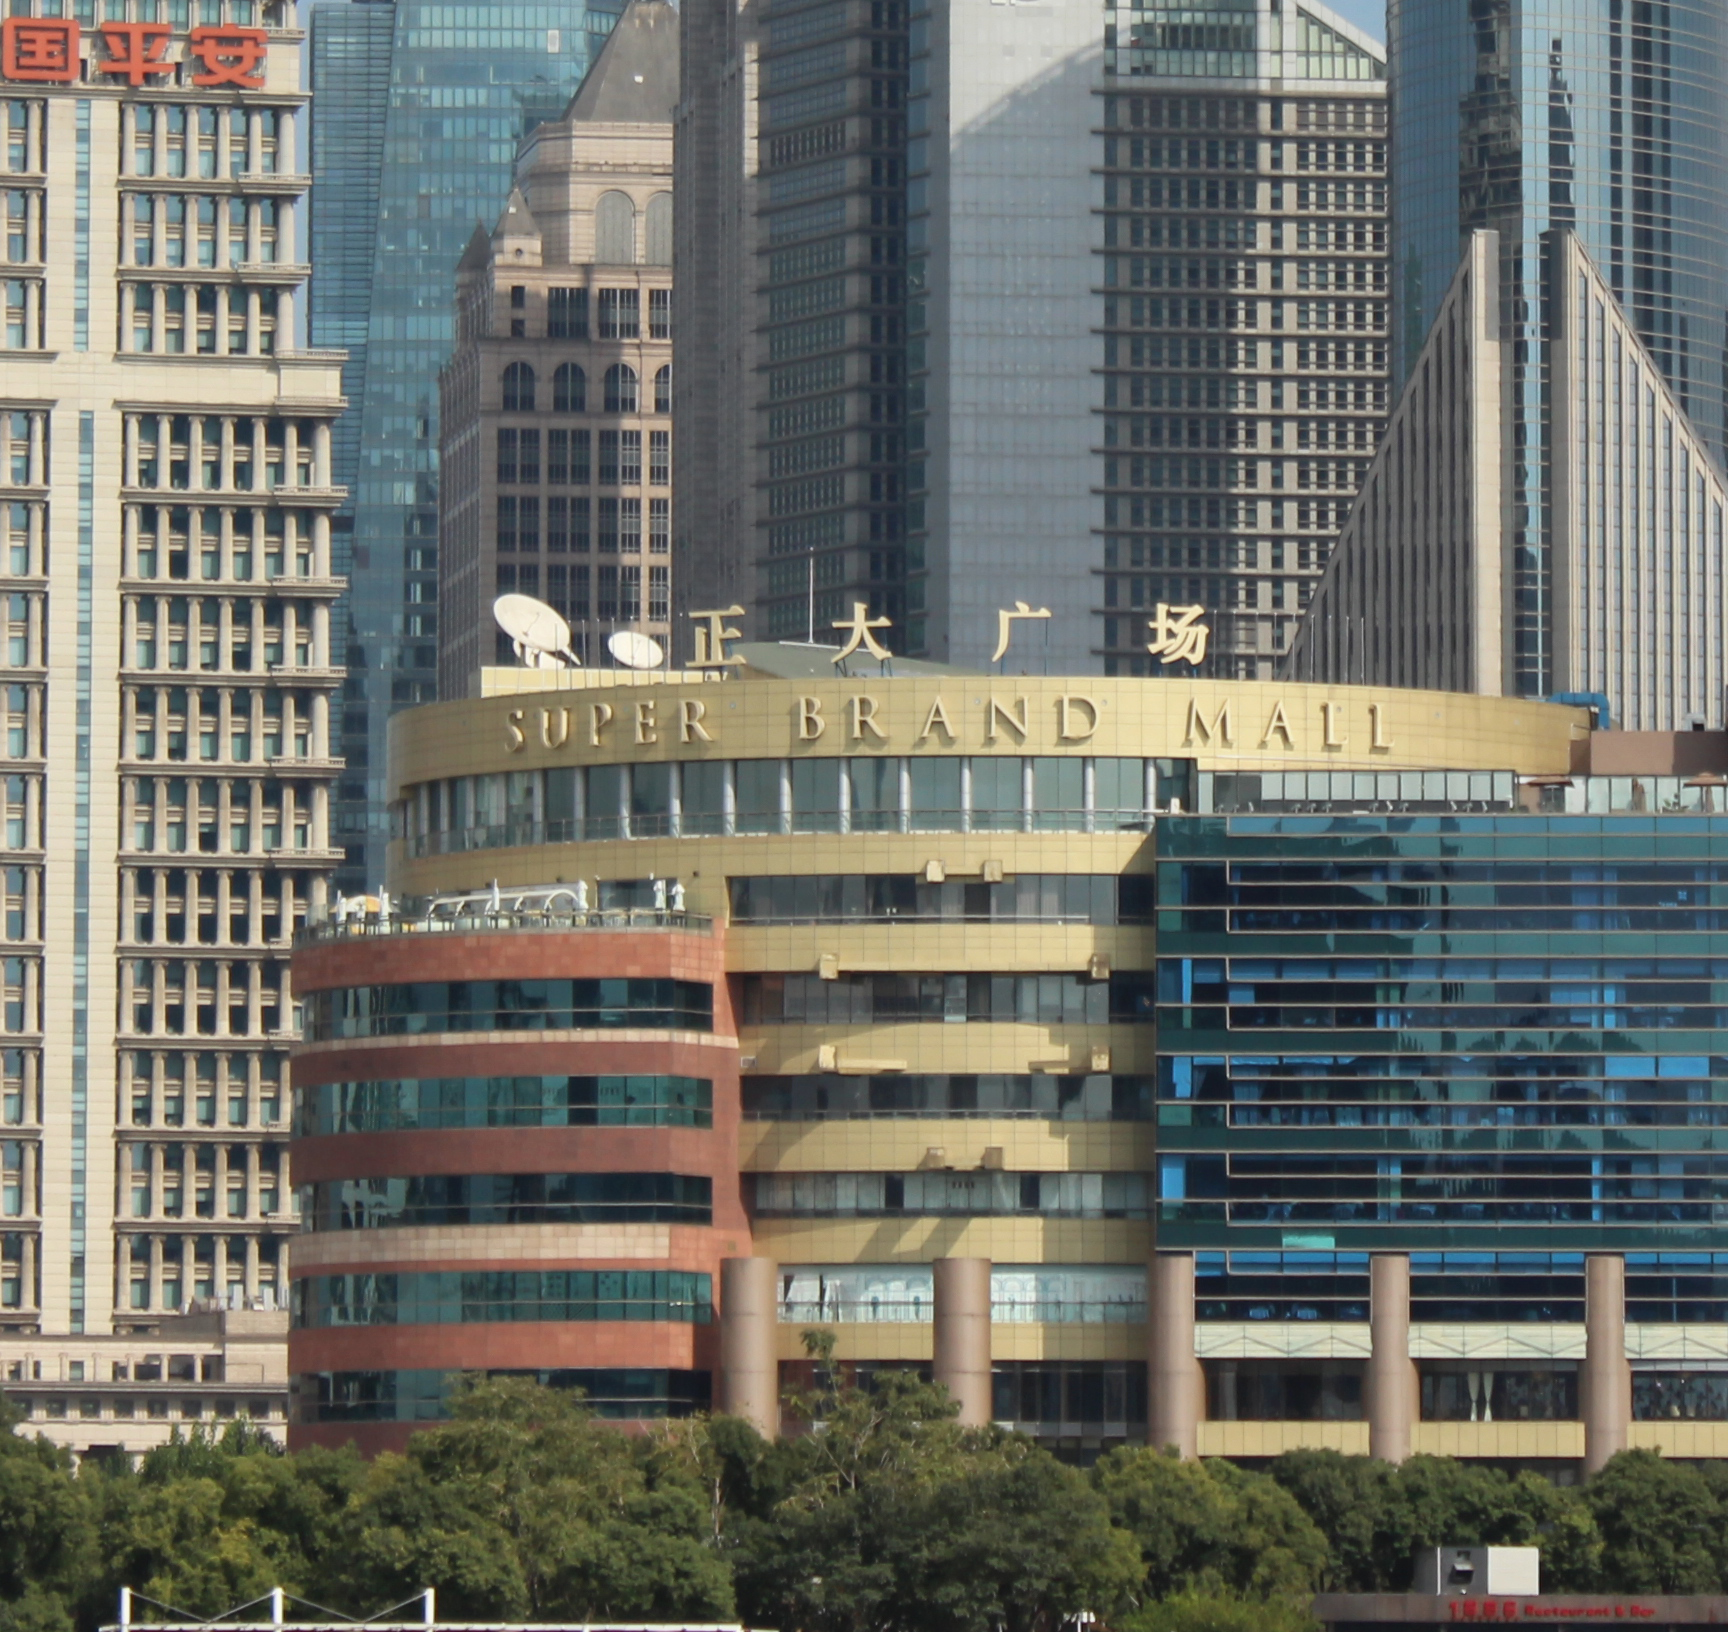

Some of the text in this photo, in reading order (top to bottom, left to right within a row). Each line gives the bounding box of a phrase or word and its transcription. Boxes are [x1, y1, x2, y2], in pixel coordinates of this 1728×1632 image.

[685, 601, 1210, 668] 正大广场
[504, 694, 1395, 752] SUPER BRAND MALL
